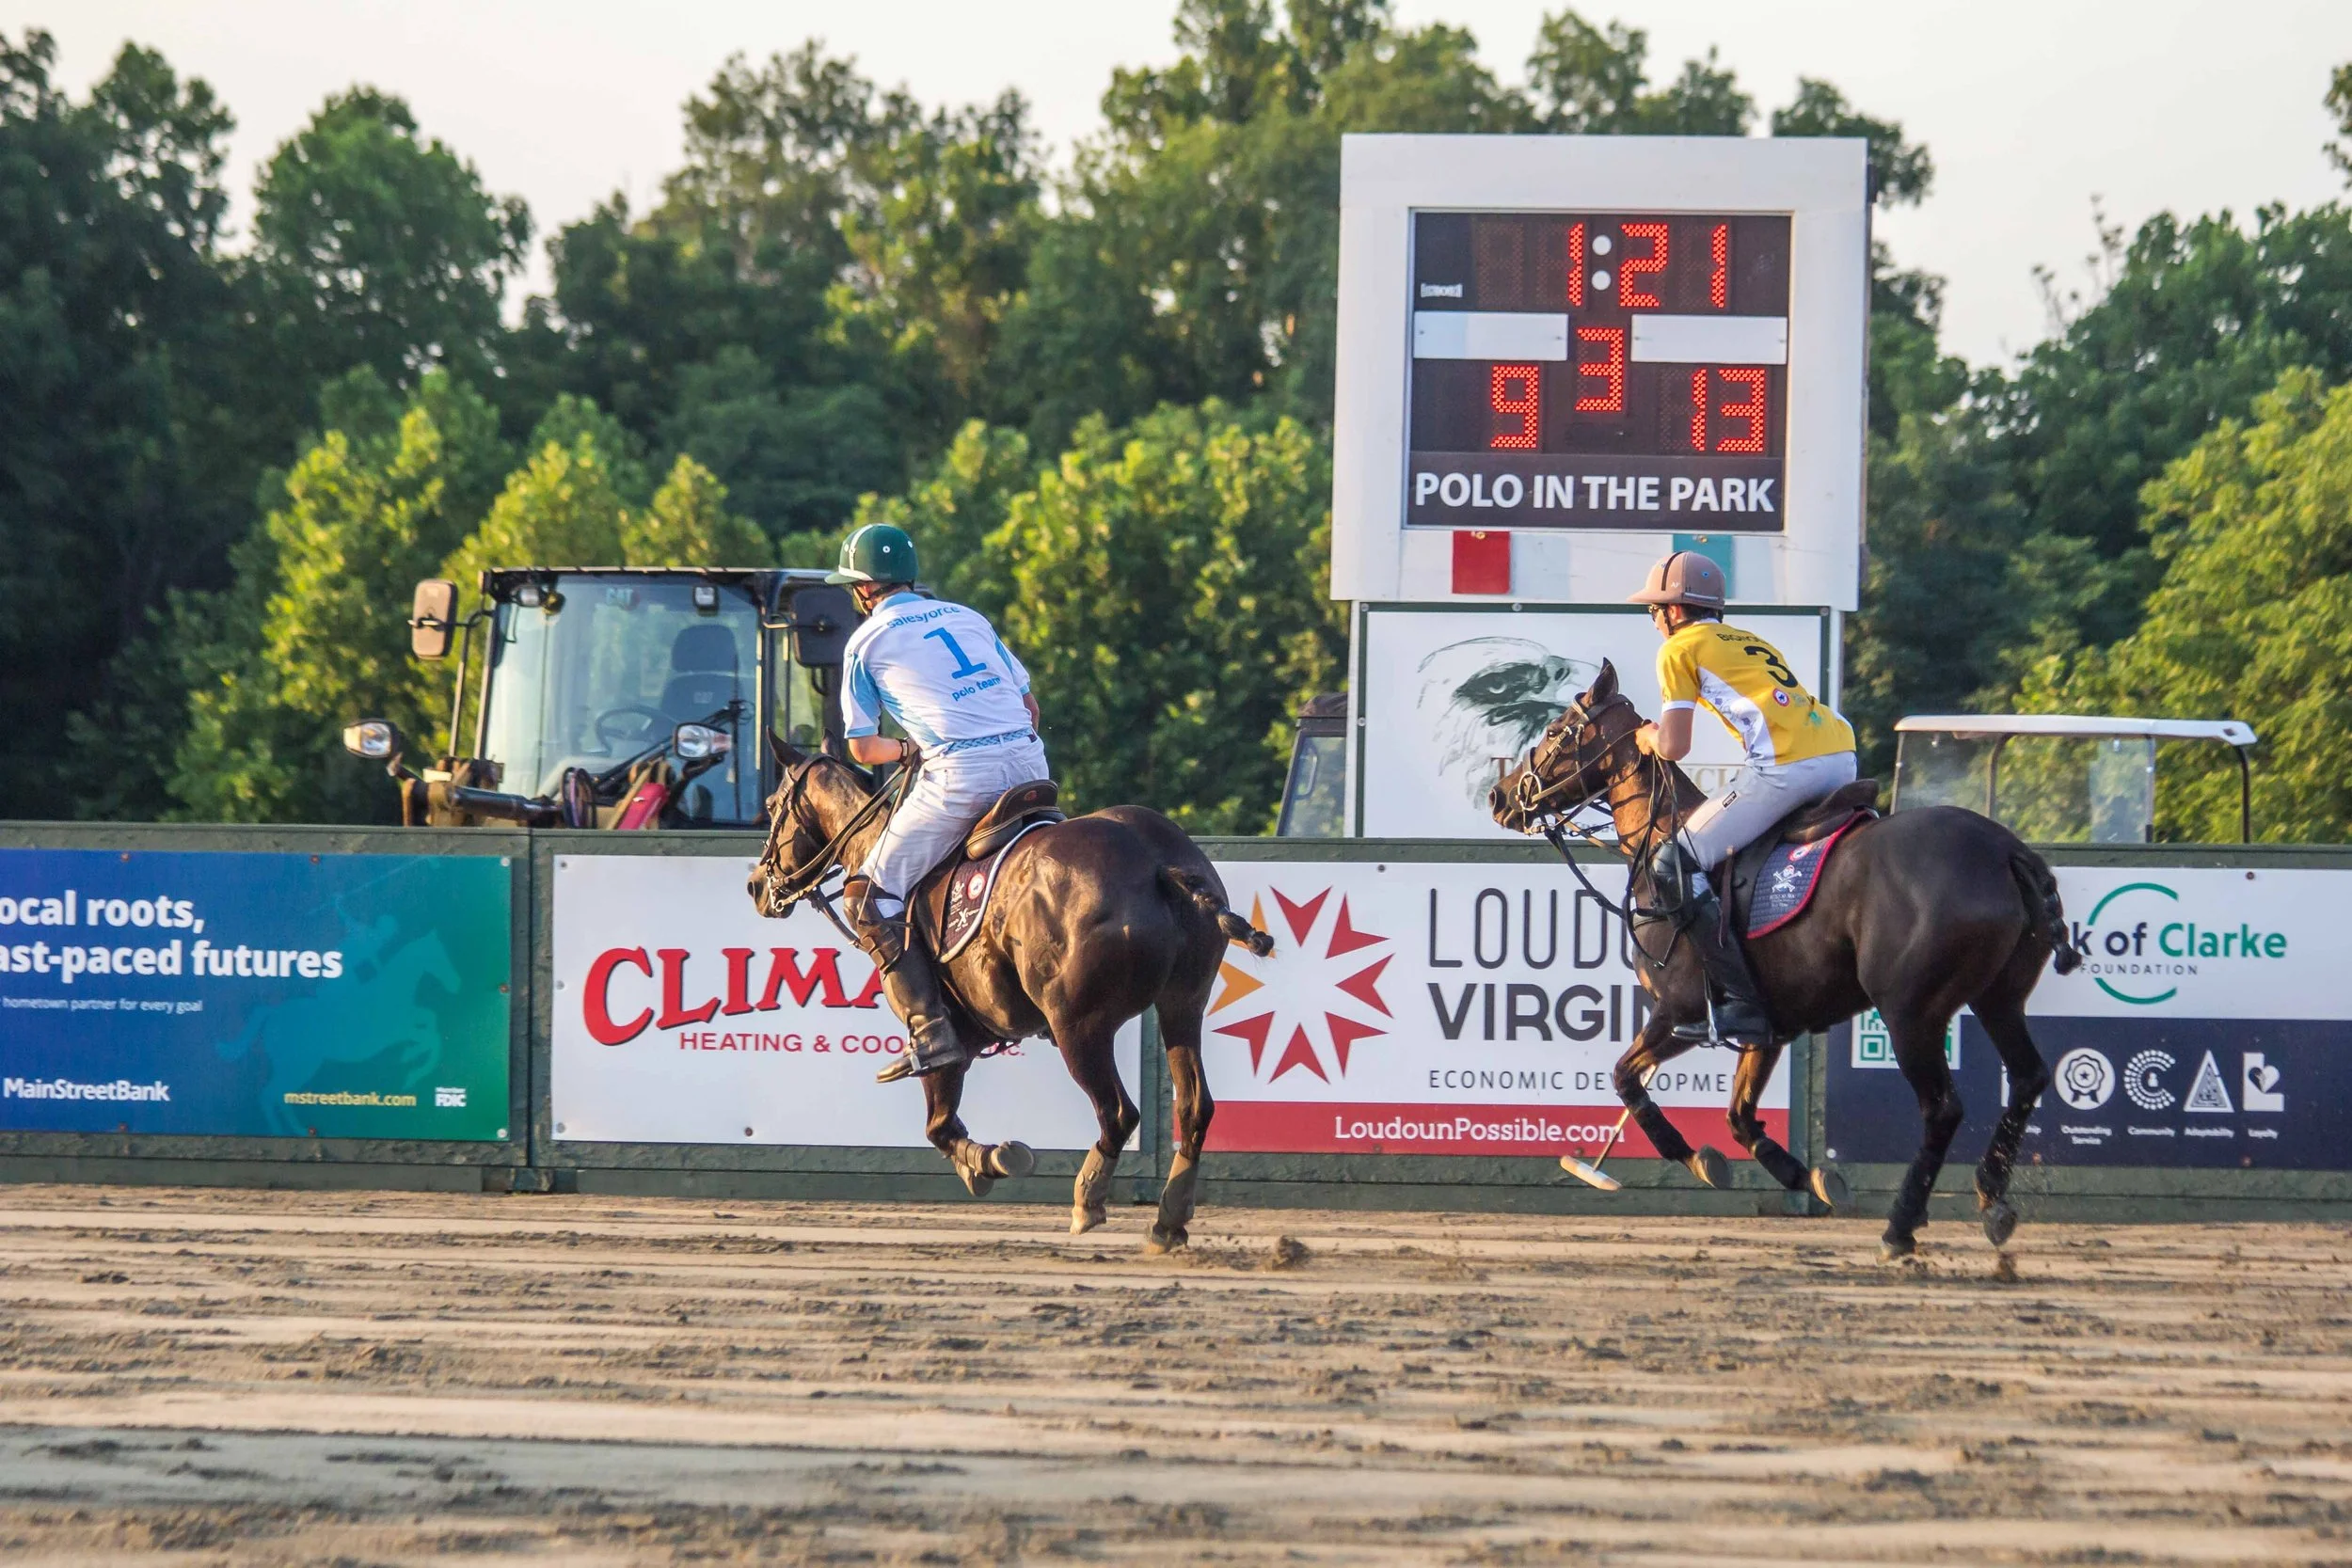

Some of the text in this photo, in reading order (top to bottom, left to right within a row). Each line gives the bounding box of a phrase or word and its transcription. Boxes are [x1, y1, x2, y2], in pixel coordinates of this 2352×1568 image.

[1575, 327, 1623, 412] 3
[1490, 366, 1539, 449] 9
[1692, 369, 1766, 452] 13
[1415, 472, 1775, 513] POLO IN THE PARK
[886, 607, 961, 629] salesforce
[923, 627, 987, 679] 1
[1743, 645, 1798, 688] 3
[952, 677, 1001, 702] polo team
[87, 895, 205, 933] roots,
[2105, 922, 2148, 957] of
[2159, 923, 2287, 958] Clarke
[191, 940, 343, 979] futures
[2080, 963, 2198, 975] FOUNDATION
[3, 997, 203, 1015] hometown partner for every goal
[679, 1032, 801, 1053] HEATING
[813, 1035, 831, 1053] &
[3, 1078, 170, 1101] MainStreetBank
[1429, 1070, 1564, 1091] ECONOMIC
[284, 1091, 417, 1107] mstreetbank.com
[435, 1094, 467, 1107] FDIC
[1335, 1117, 1625, 1143] LoudounPossible.com
